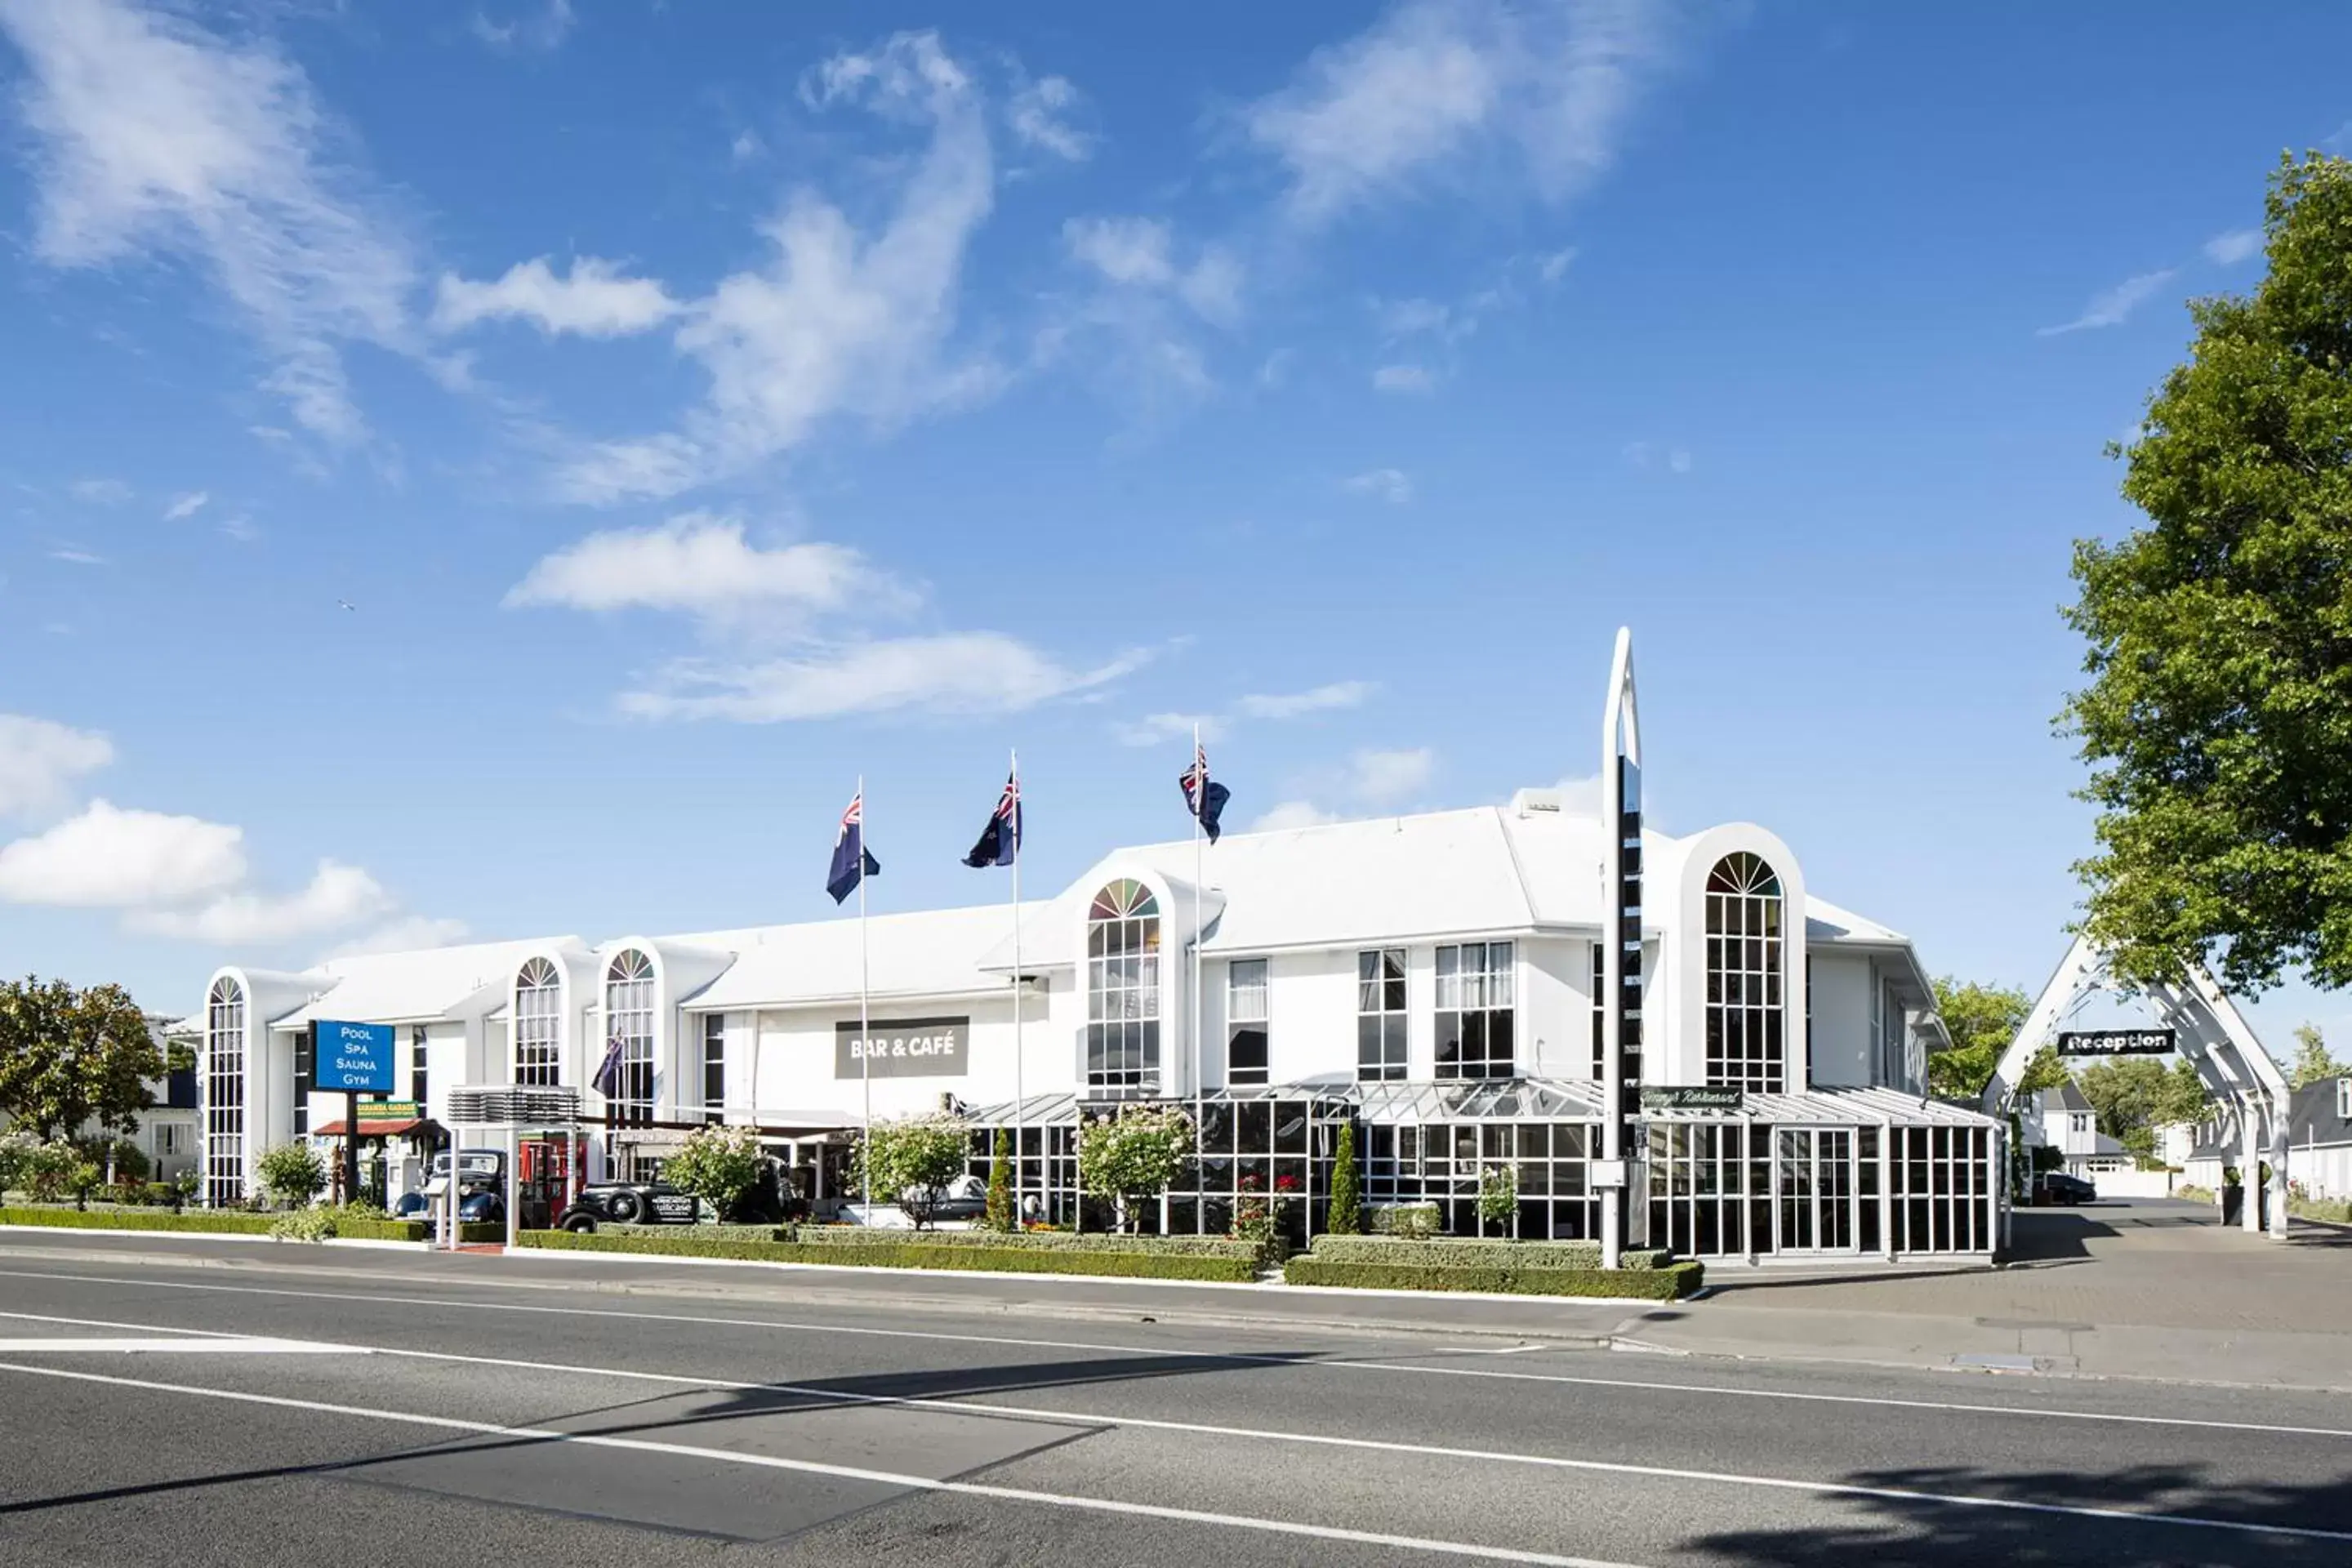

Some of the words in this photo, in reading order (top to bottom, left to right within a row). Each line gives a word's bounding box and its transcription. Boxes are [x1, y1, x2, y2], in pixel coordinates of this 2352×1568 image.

[341, 1027, 373, 1040] POOL
[851, 1039, 888, 1058] BAR
[892, 1039, 906, 1057] &
[909, 1030, 955, 1057] CAFÉ
[2067, 1033, 2167, 1051] Reception
[345, 1043, 369, 1055] SPA
[336, 1058, 376, 1071] SAUNA
[342, 1074, 369, 1086] GYM
